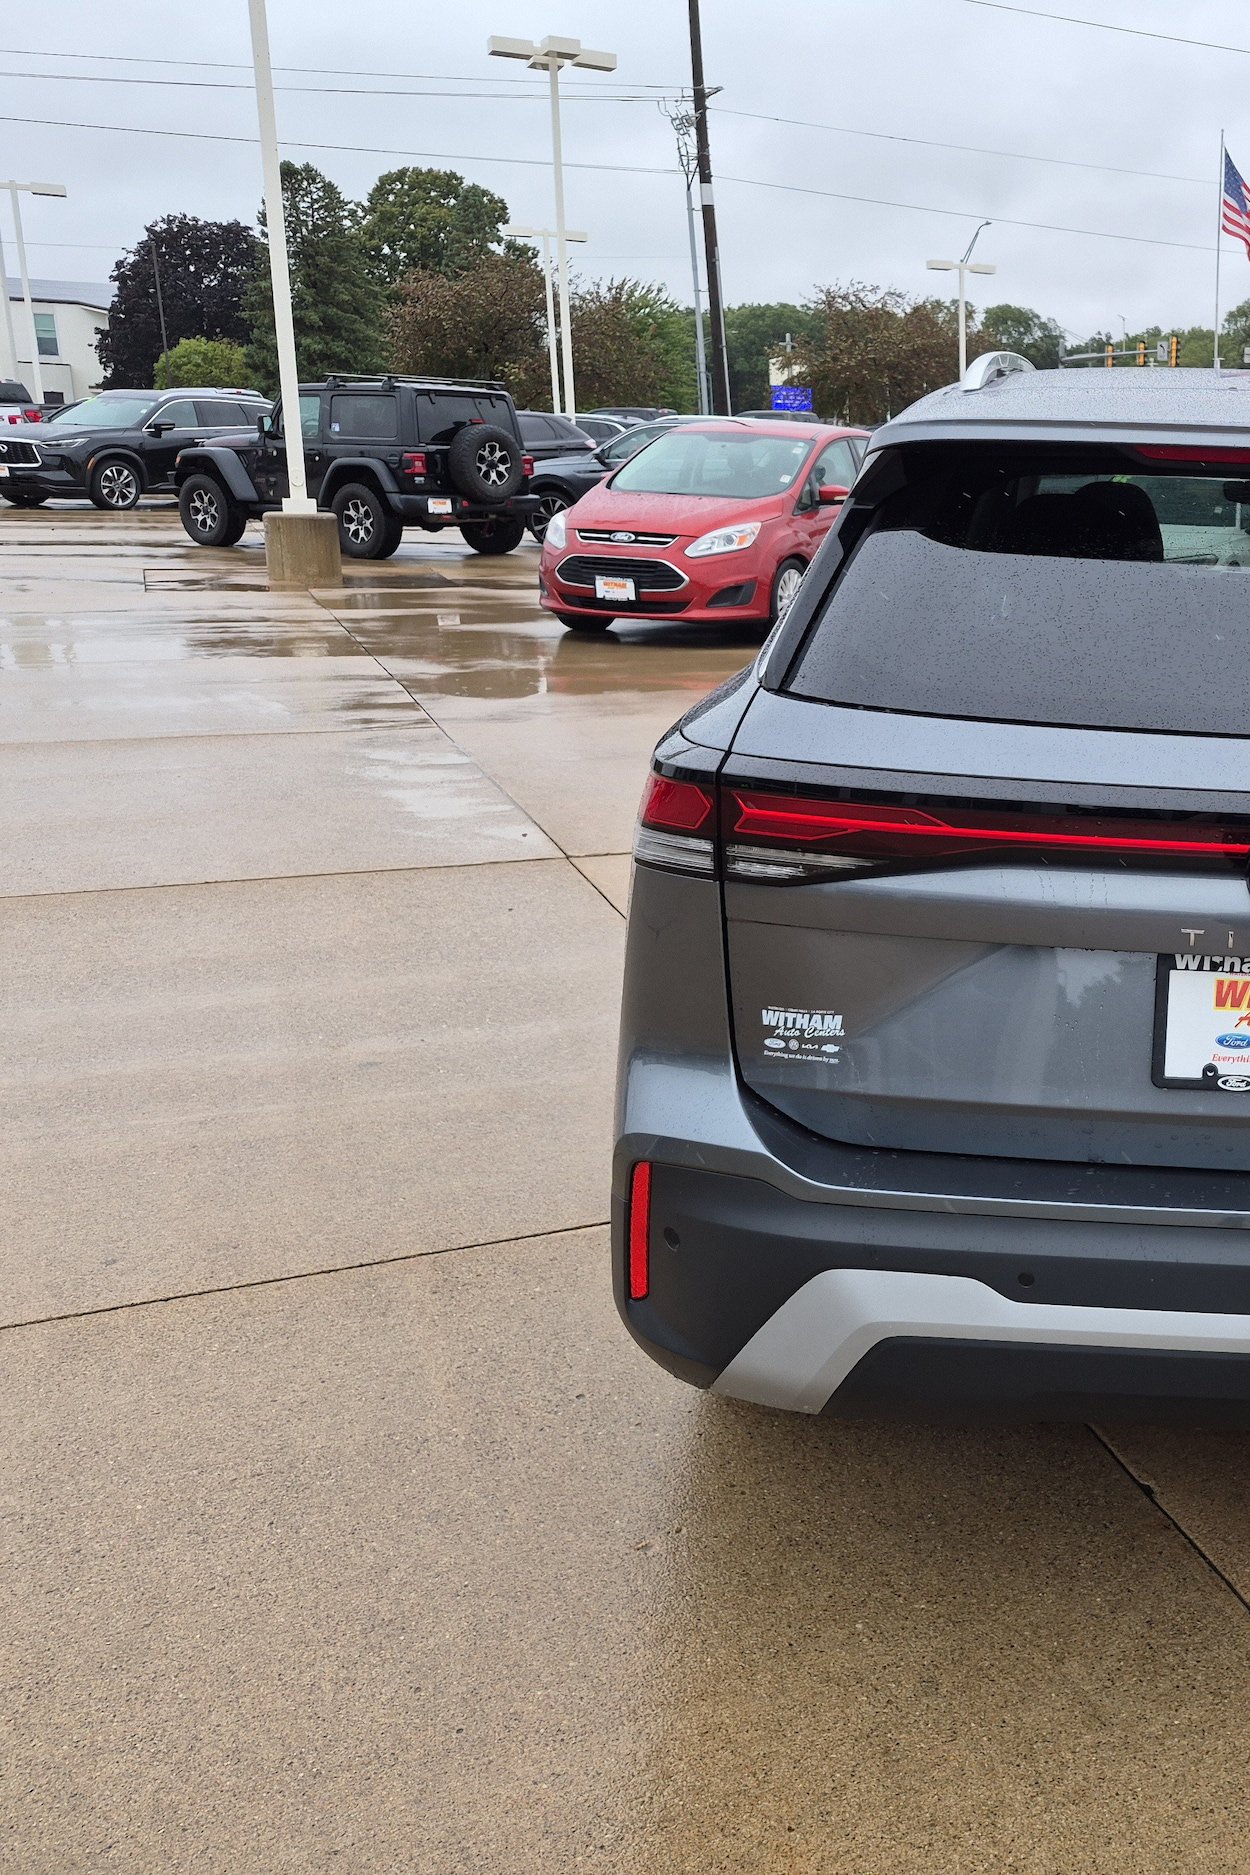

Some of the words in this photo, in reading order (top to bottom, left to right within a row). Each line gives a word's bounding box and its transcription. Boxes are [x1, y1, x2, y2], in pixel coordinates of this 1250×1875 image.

[762, 1009, 843, 1030] WITHAM
[773, 1025, 802, 1037] Auto
[804, 1025, 846, 1039] Centers
[1220, 1035, 1249, 1048] Ford
